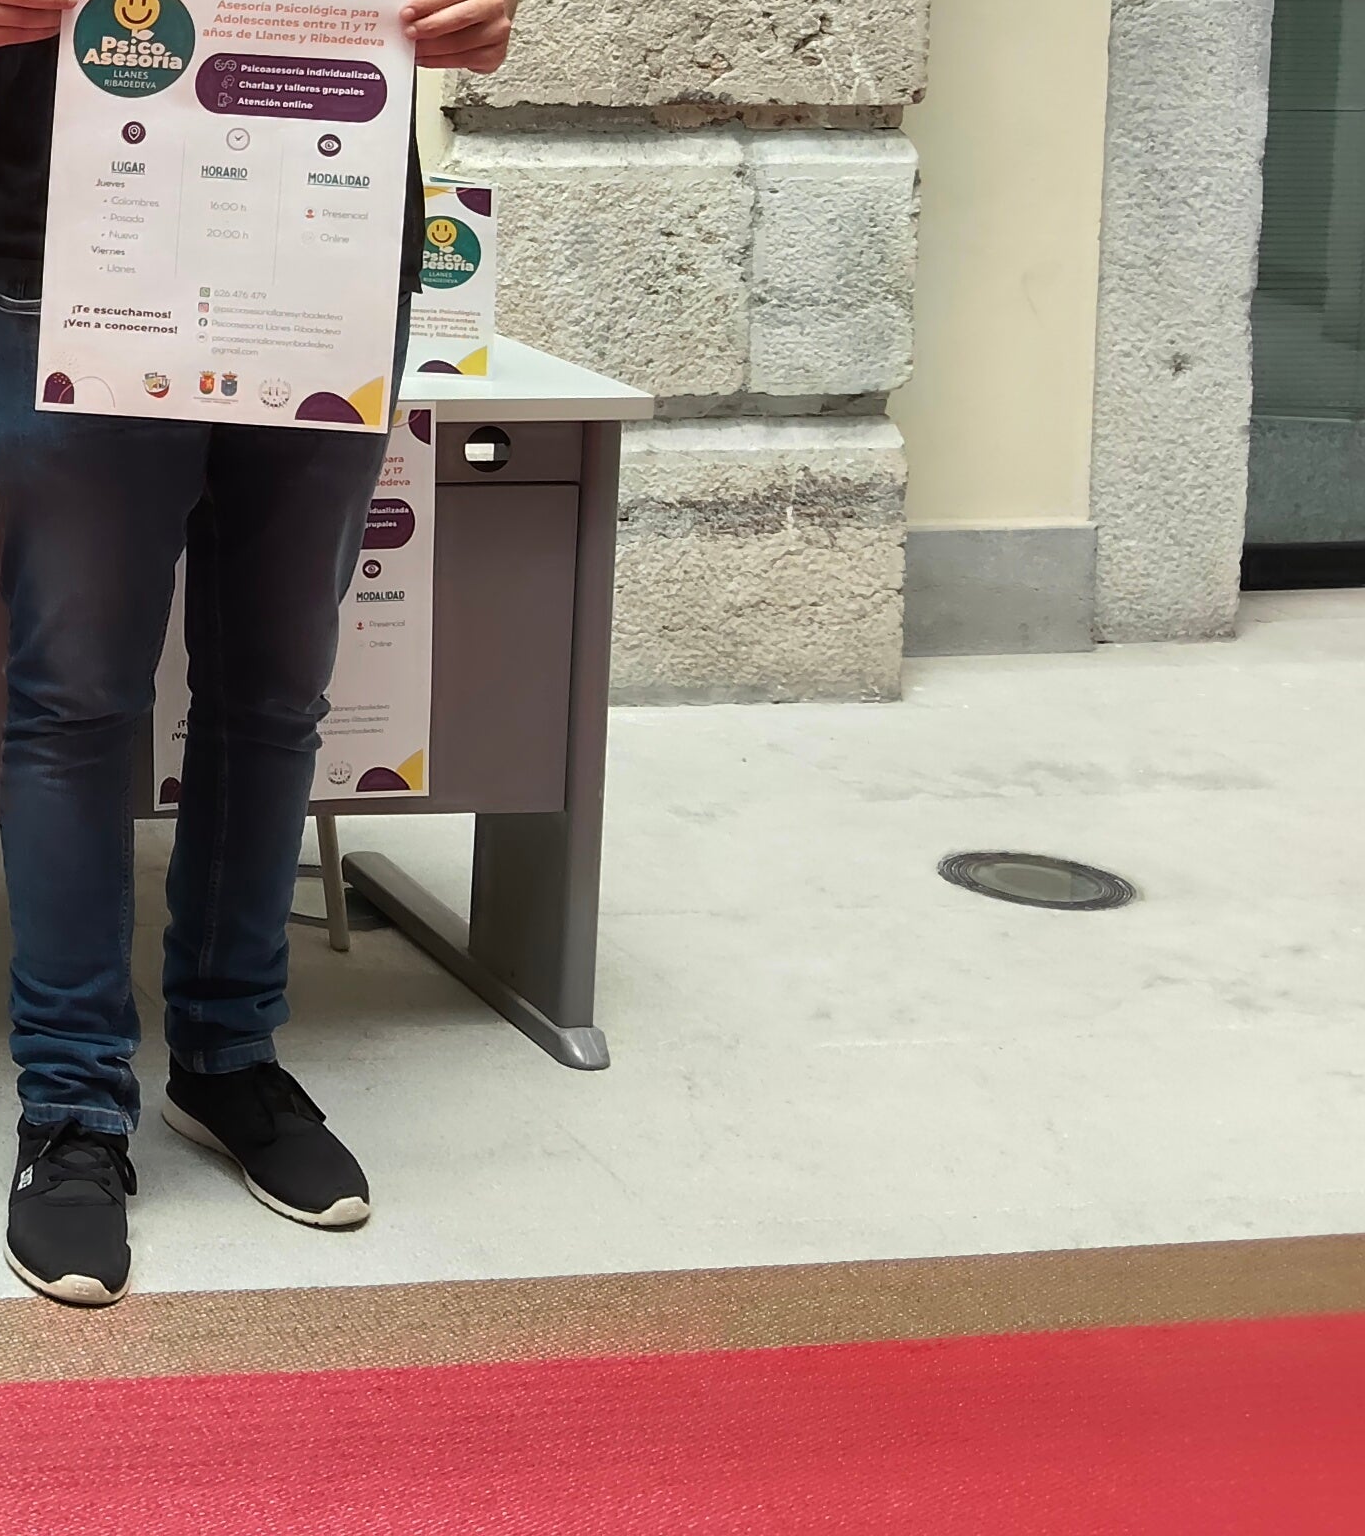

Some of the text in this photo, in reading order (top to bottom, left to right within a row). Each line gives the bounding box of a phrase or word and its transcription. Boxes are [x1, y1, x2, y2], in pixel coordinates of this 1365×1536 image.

[216, 0, 379, 19] Asesoría Psicológica para
[213, 13, 376, 32] Adolescentes entre 11 17
[202, 27, 385, 46] años de Llanes Ribadedeva
[100, 35, 166, 55] Psico
[82, 46, 183, 70] Asesoría
[112, 69, 149, 80] LLANES
[240, 63, 381, 80] Psicoasesoría individualizada
[103, 78, 156, 89] RIBADEDEVA
[237, 80, 365, 97] Charlas talleres grupales
[236, 96, 313, 109] Atención online
[111, 160, 146, 173] LUGAR
[200, 165, 248, 179] HORARIO
[94, 177, 125, 188] Jueves
[307, 172, 370, 187] MODALIDAD
[111, 195, 160, 207] Colombres
[209, 200, 238, 211] 16:00
[109, 212, 144, 223] Posada
[321, 208, 368, 220] Presencial
[108, 229, 138, 240] Nueva
[206, 228, 240, 239] 20:00
[319, 232, 350, 244] Online
[90, 245, 125, 256] Viernes
[106, 263, 136, 274] Llanes
[423, 259, 474, 272] sesoría
[71, 304, 171, 319] ¡Te escuchamos!
[63, 318, 178, 334] ¡Ven conocernos!
[384, 467, 404, 476] y 17
[356, 590, 405, 602] MODALIDAD
